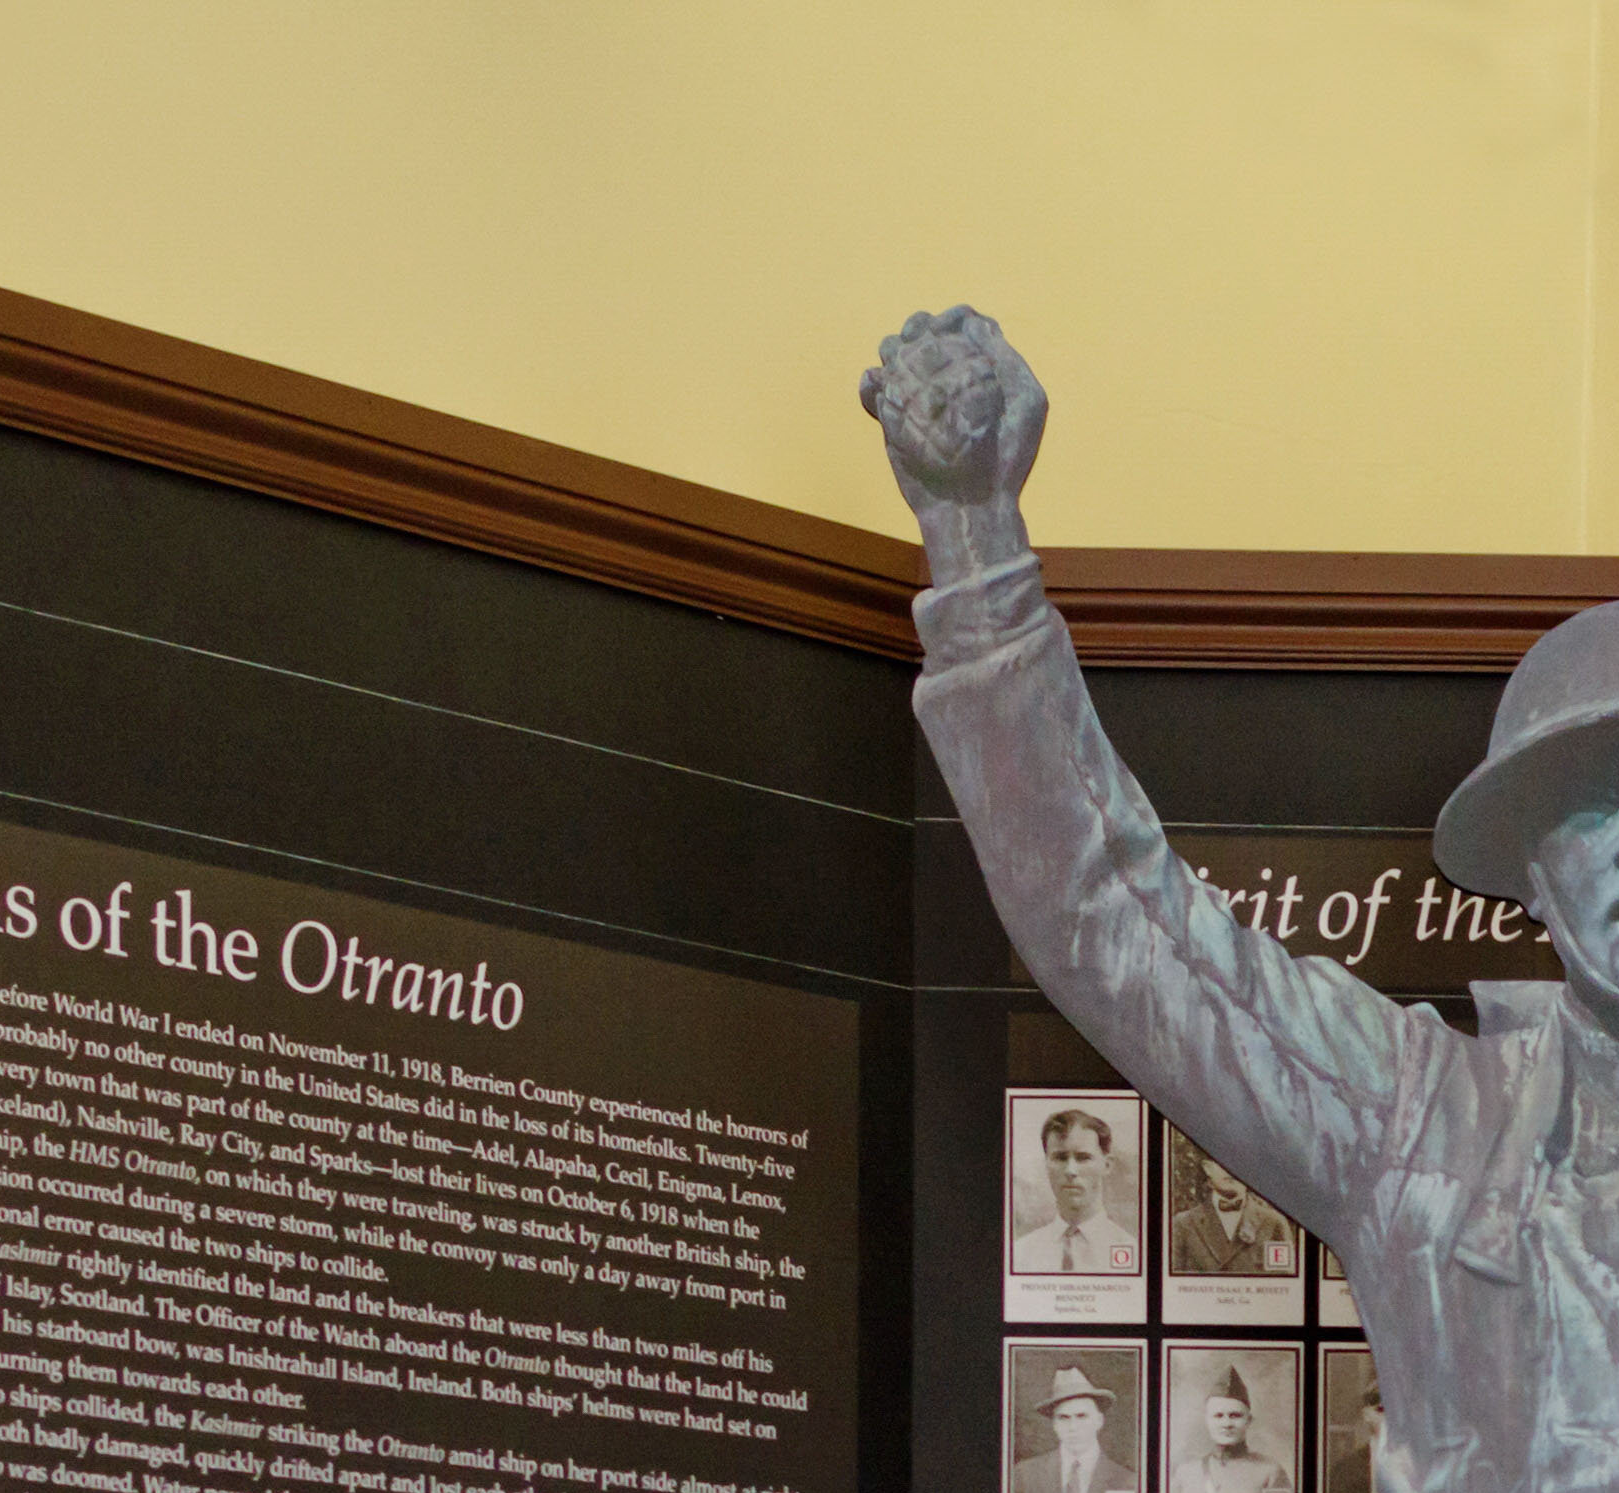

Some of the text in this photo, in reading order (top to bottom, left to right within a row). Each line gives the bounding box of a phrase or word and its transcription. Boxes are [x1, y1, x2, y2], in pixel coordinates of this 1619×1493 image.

[58, 879, 133, 958] of
[150, 887, 259, 982] the
[280, 918, 524, 1031] Otranto
[1318, 868, 1401, 965] of
[1414, 870, 1522, 942] the
[51, 989, 114, 1025] World
[117, 1002, 160, 1033] War
[161, 1011, 172, 1036] I
[173, 1018, 235, 1047] ended
[237, 1032, 265, 1053] on
[267, 1030, 368, 1071] November
[370, 1050, 396, 1079] 11,
[400, 1055, 447, 1088] 1918,
[449, 1064, 516, 1098] Berrien
[517, 1077, 586, 1116] County
[587, 1095, 692, 1130] experienced
[694, 1108, 724, 1136] the
[725, 1113, 789, 1147] horrors
[788, 1128, 810, 1150] of
